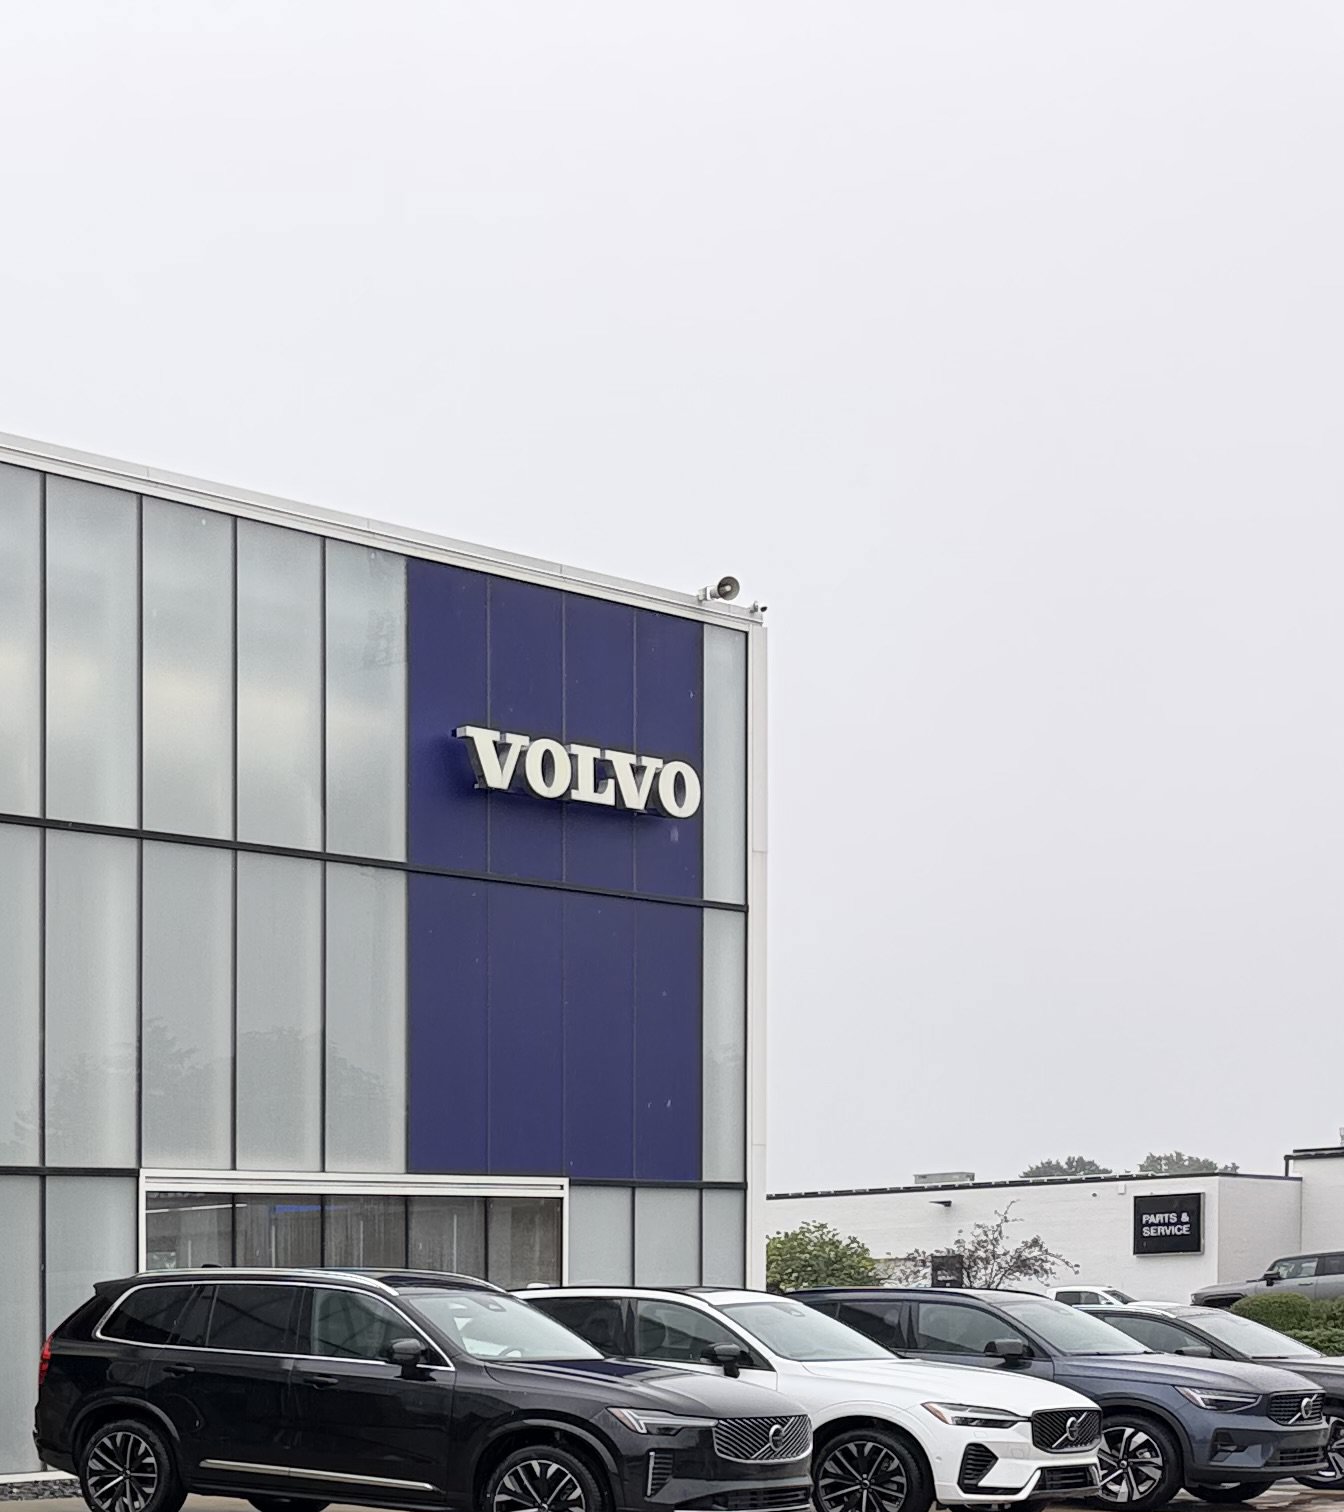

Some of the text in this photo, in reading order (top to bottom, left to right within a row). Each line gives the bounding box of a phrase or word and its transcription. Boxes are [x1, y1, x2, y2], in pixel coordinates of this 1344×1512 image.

[455, 725, 702, 819] VOLVO
[1142, 1212, 1190, 1224] PARTS &
[1142, 1224, 1191, 1237] SERVICE
